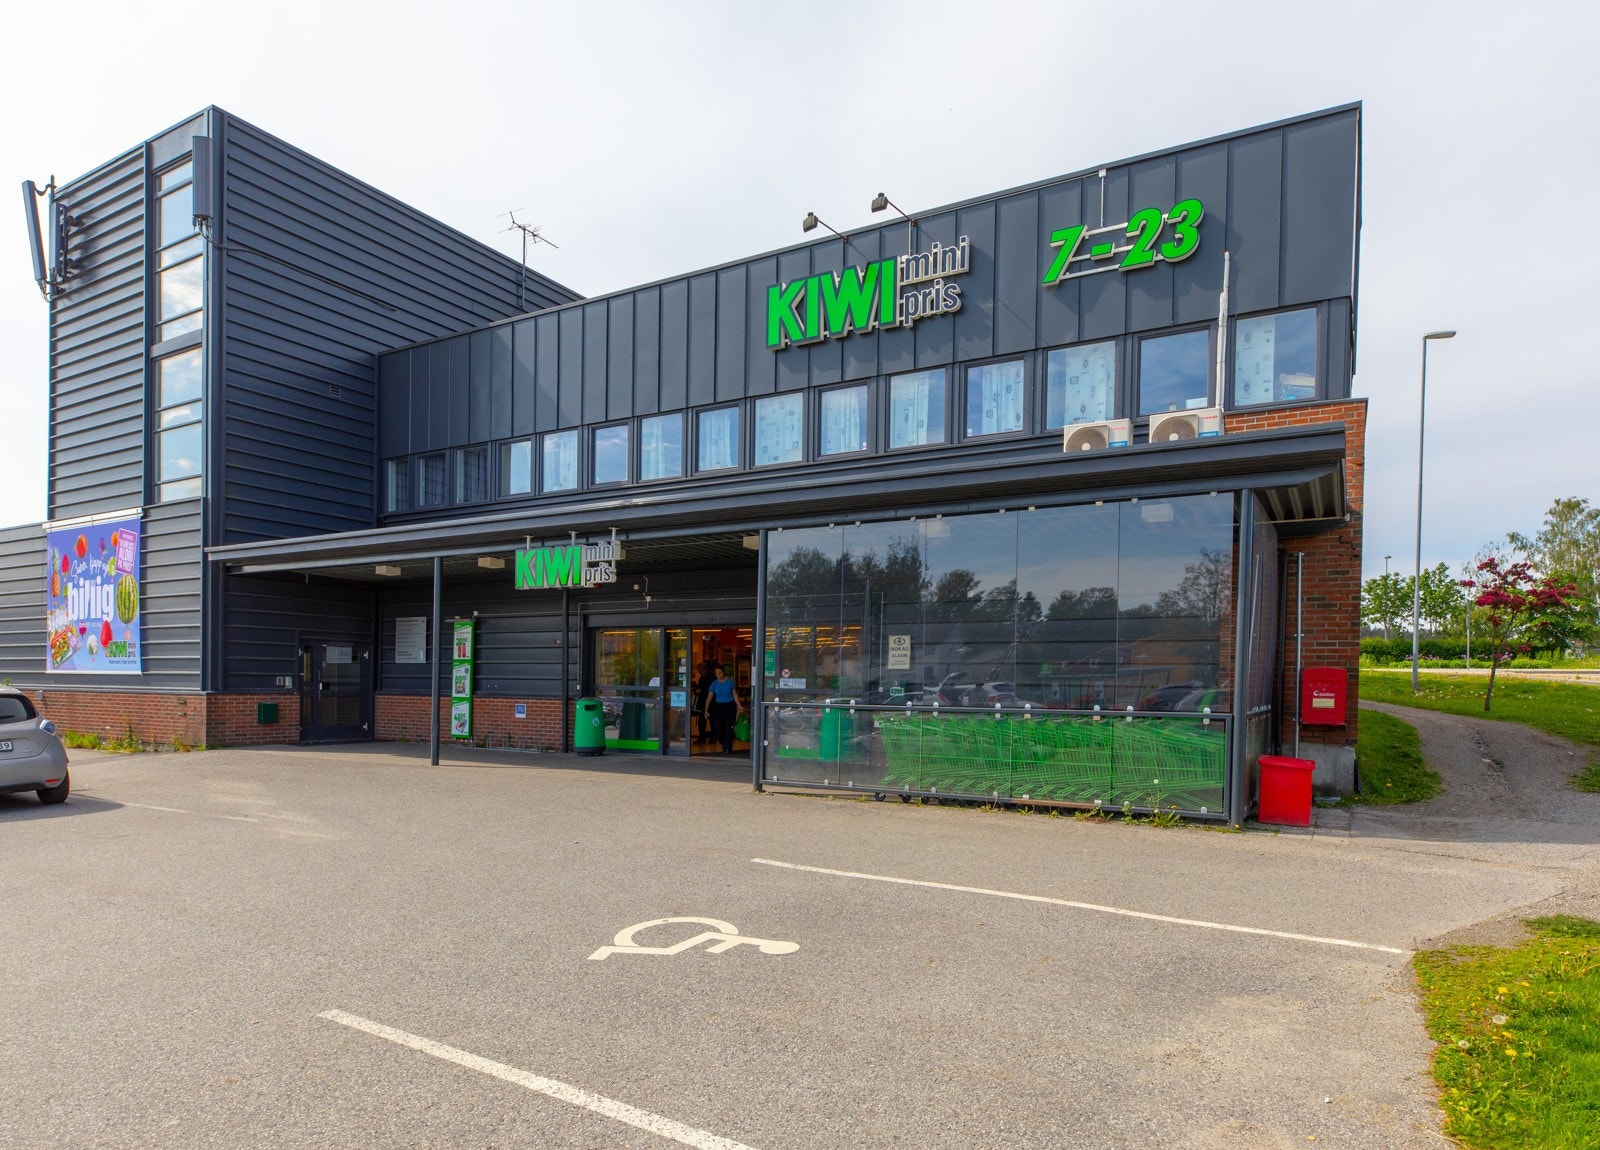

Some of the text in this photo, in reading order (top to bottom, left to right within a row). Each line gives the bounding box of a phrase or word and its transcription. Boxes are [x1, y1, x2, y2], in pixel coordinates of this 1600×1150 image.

[904, 235, 969, 285] mini
[766, 255, 899, 350] KIWI
[903, 278, 961, 328] pris
[515, 545, 582, 589] KIWI
[585, 541, 617, 561] mini
[68, 575, 114, 622] billig
[584, 563, 612, 587] pris
